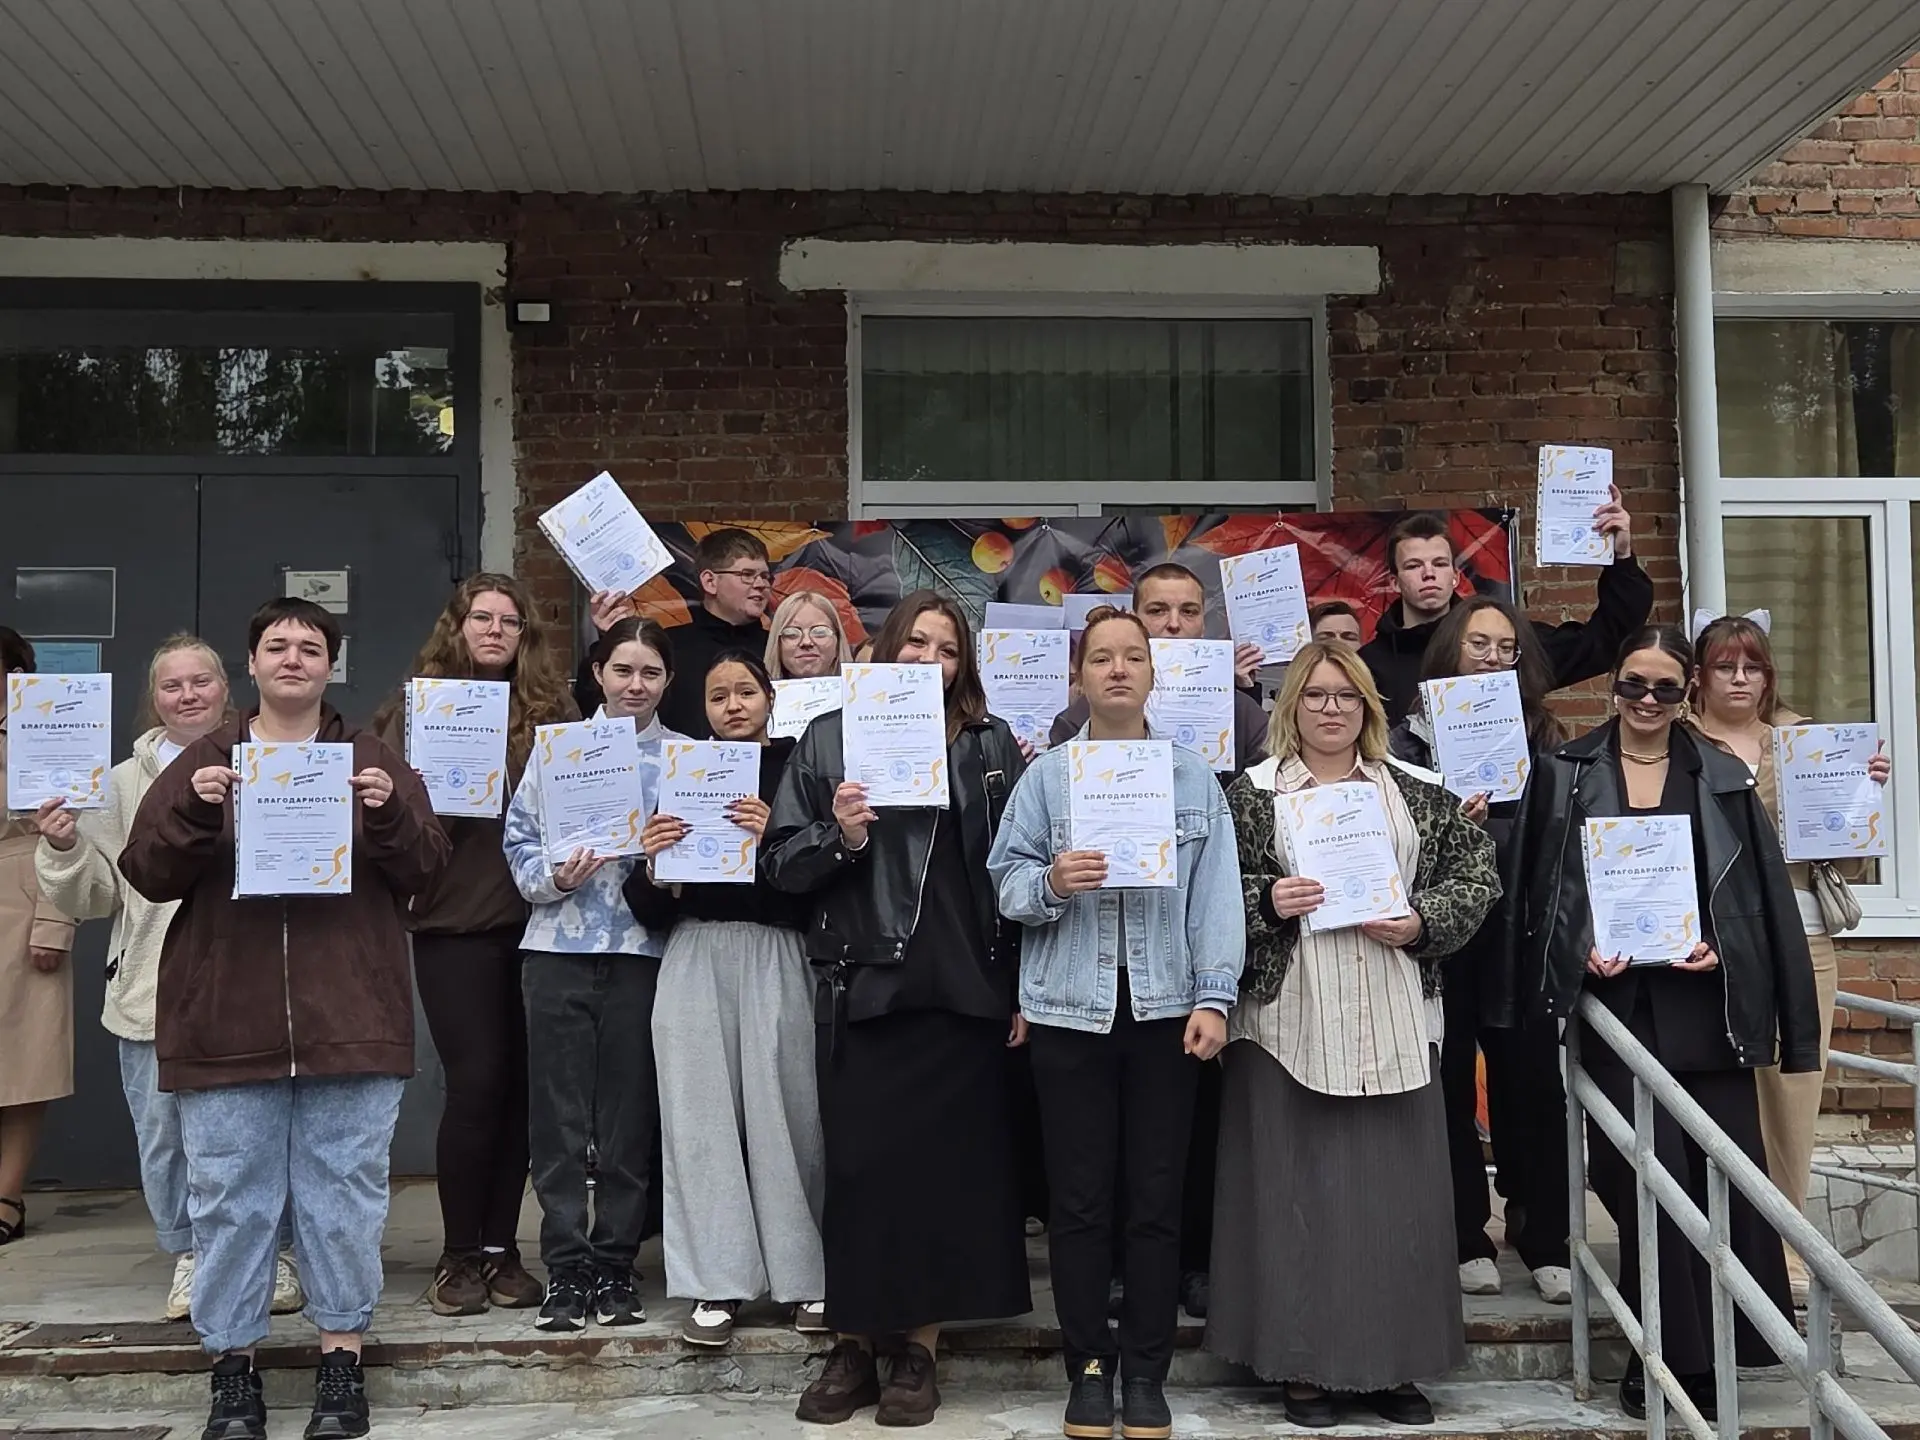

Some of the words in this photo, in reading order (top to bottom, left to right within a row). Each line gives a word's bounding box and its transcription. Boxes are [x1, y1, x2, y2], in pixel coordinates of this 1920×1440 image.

[1235, 585, 1294, 600] БЛАГОДАРНОСТЬ
[858, 713, 932, 721] БЛАГОДАРНОСТЬ
[424, 725, 495, 733] БЛАГОДАРНОСТЬ
[1447, 718, 1514, 731] БЛАГОДАРНОСТЬ
[554, 766, 627, 781] БЛАГОДАРНОСТЬ
[1795, 770, 1867, 780] БЛАГОДАРНОСТЬ
[257, 796, 340, 804] БЛАГОДАРНОСТЬ
[1083, 792, 1161, 800] БЛАГОДАРНОСТЬ
[1308, 830, 1382, 846] БЛАГОДАРНОСТЬ
[1604, 866, 1681, 876] БЛАГОДАРНОСТЬ
